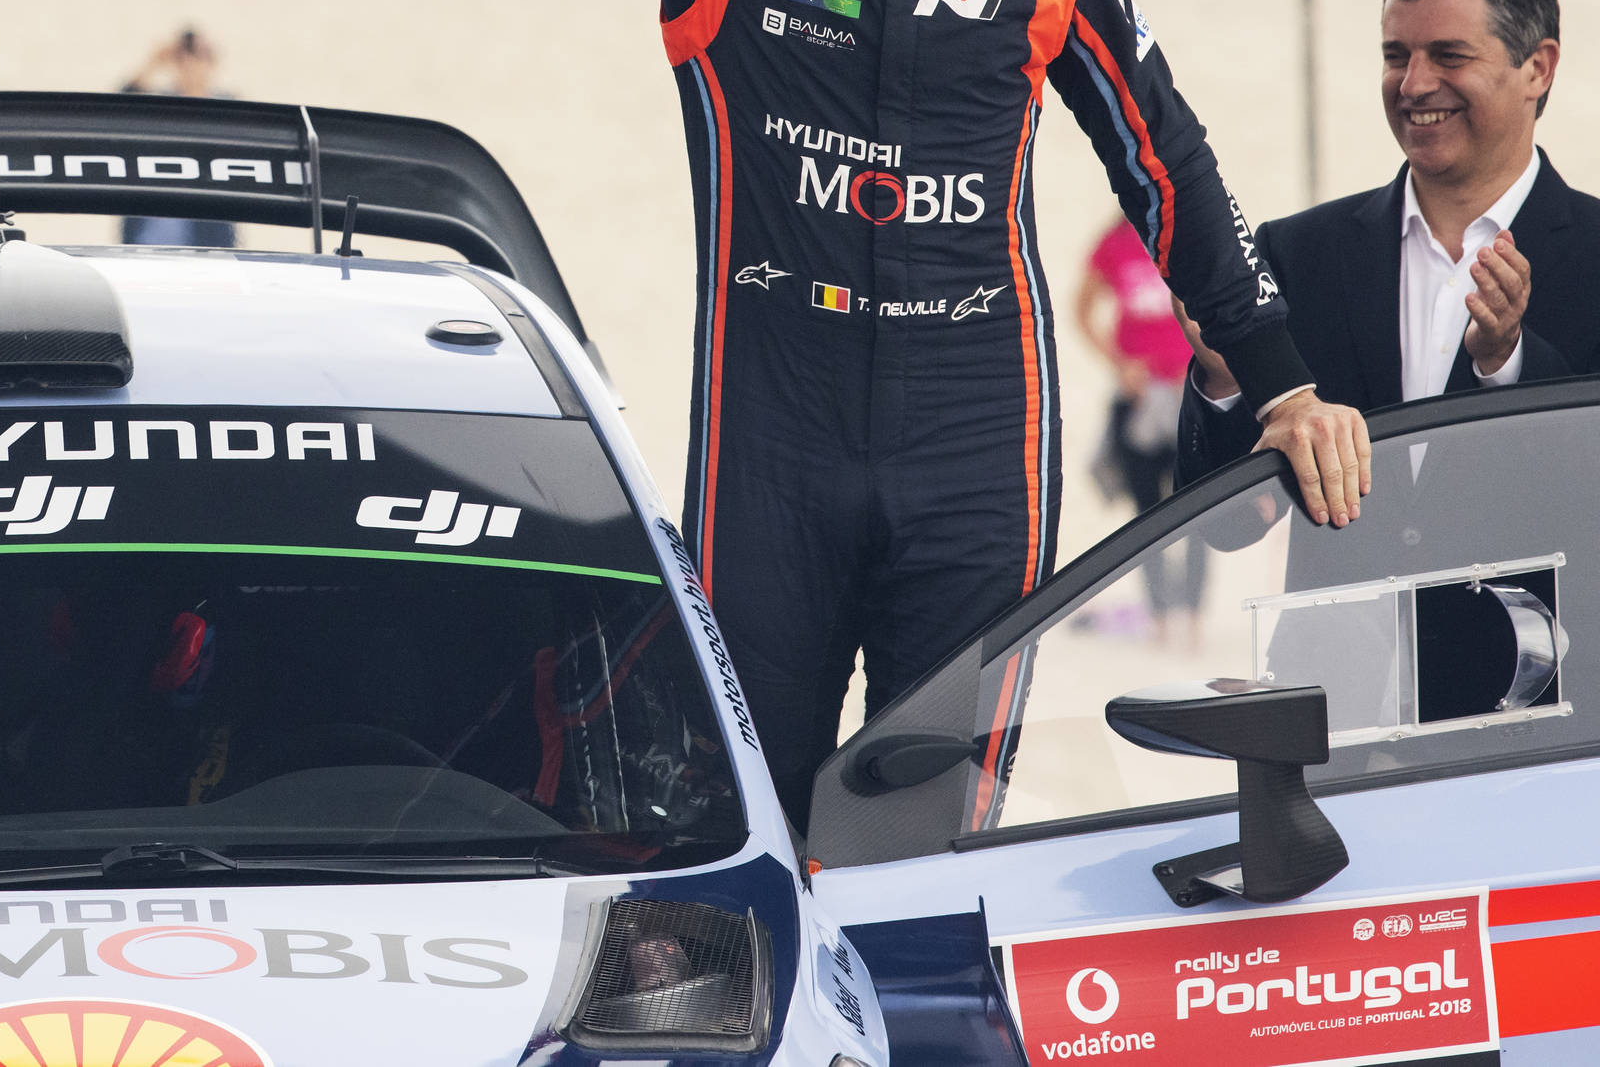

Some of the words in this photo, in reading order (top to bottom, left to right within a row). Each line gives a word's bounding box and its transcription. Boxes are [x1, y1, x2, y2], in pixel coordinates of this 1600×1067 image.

[789, 17, 856, 45] BAUMA
[764, 113, 901, 168] HYUNDAI
[795, 155, 986, 226] MOBIS
[857, 297, 871, 312] T.
[879, 299, 947, 317] NEUVILLE
[1419, 908, 1467, 924] WRC
[1174, 951, 1240, 974] rally
[1245, 947, 1280, 966] de
[1176, 949, 1469, 1021] Portugal
[1429, 998, 1472, 1017] 2018
[1250, 1021, 1316, 1038] AUTOMÓVEL
[1318, 1017, 1346, 1030] CLUB
[1348, 1015, 1363, 1026] DE
[1365, 1008, 1426, 1025] PORTUGAL
[1042, 1028, 1156, 1060] vodafone
